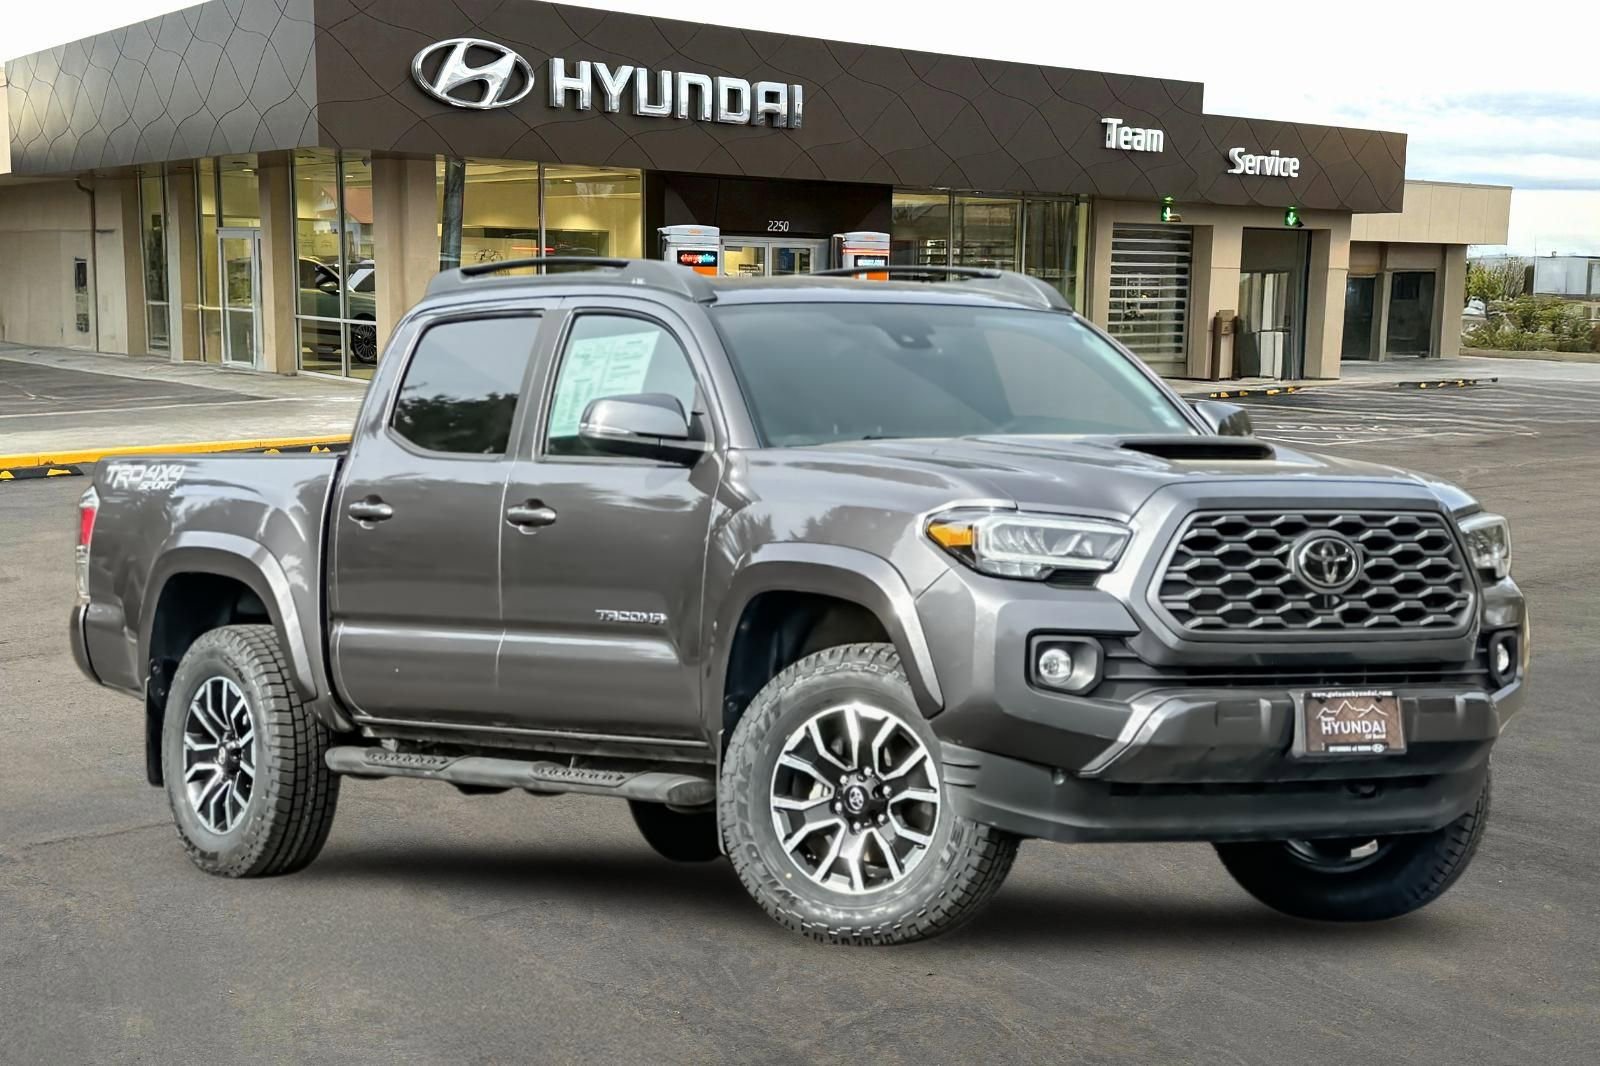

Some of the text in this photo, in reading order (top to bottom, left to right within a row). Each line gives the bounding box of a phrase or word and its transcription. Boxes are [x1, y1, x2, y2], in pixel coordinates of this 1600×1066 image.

[549, 57, 804, 129] HYUNDAI
[1101, 117, 1164, 152] Team
[1227, 147, 1300, 177] Service
[767, 220, 790, 232] 2250
[105, 464, 146, 489] TRD
[137, 481, 177, 490] SPORT
[595, 609, 668, 624] TACOMA
[1321, 719, 1386, 735] HYUNDAI
